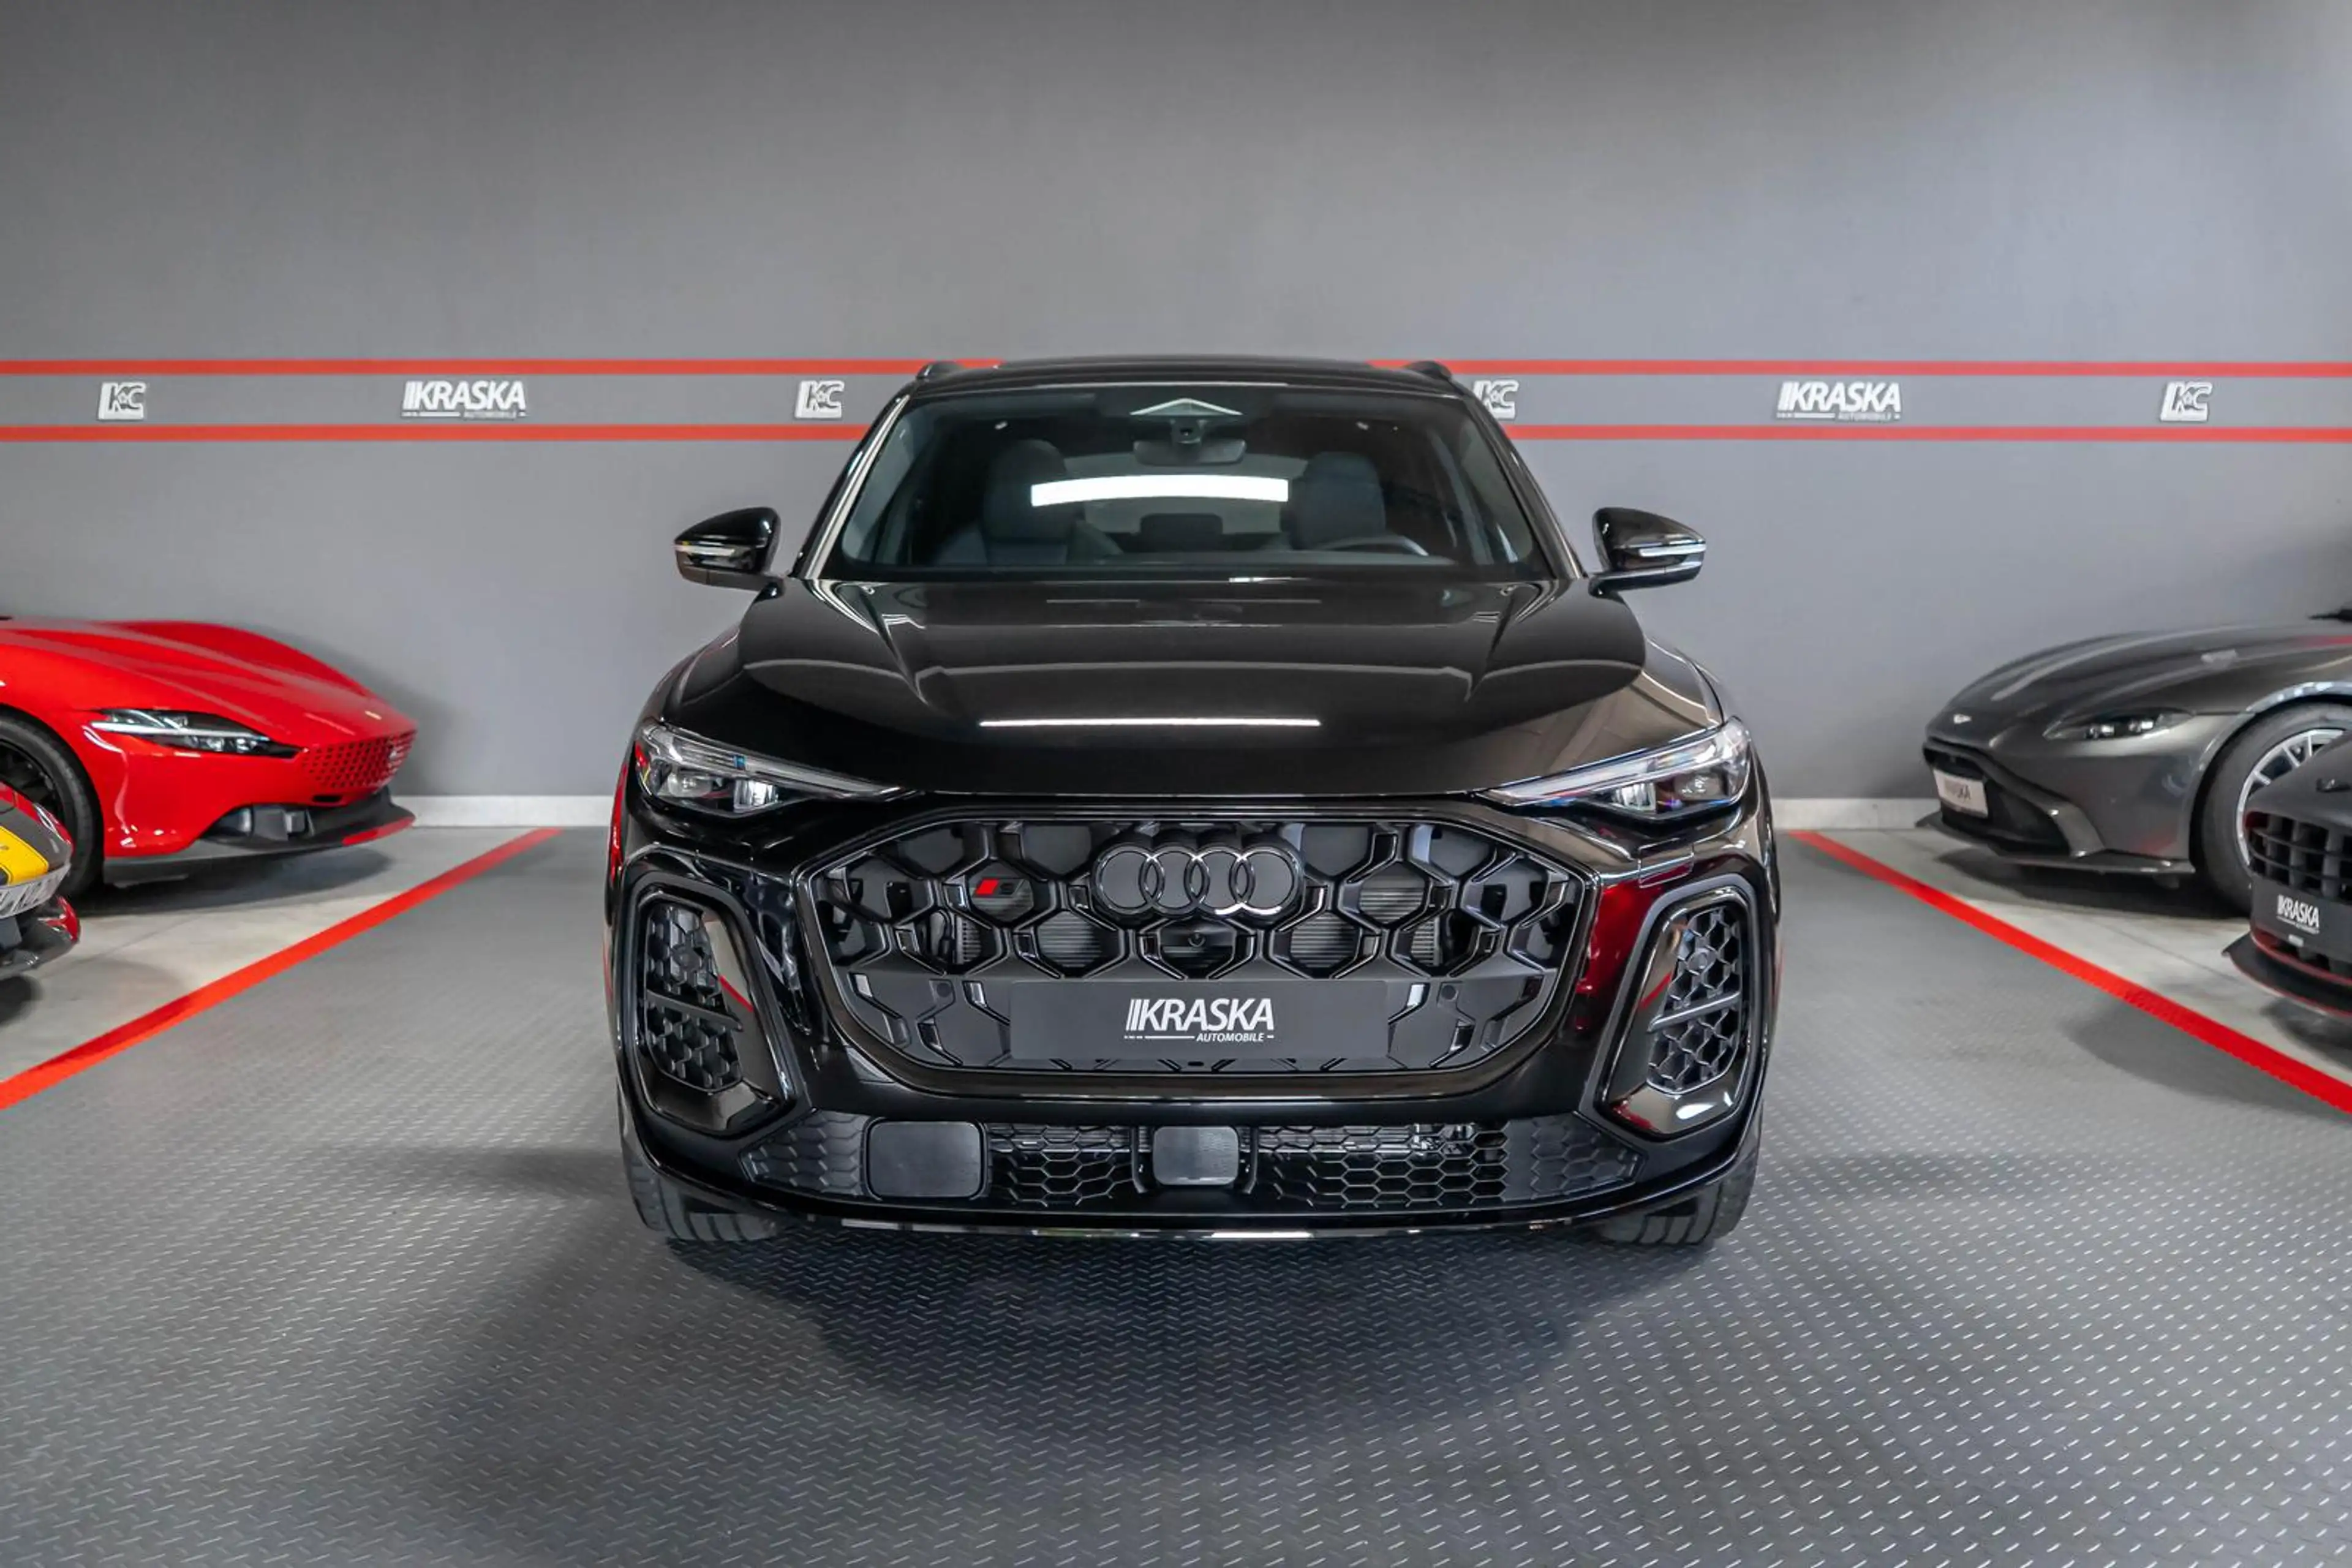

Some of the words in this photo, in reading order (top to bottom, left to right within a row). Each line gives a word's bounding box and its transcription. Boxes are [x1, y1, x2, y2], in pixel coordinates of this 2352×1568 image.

[404, 380, 526, 410] KRASKA
[1777, 382, 1901, 412] KRASKA
[2277, 894, 2320, 927] KRASKA
[1126, 998, 1274, 1031] KRASKA
[1196, 1032, 1264, 1042] AUTOMOBILE
